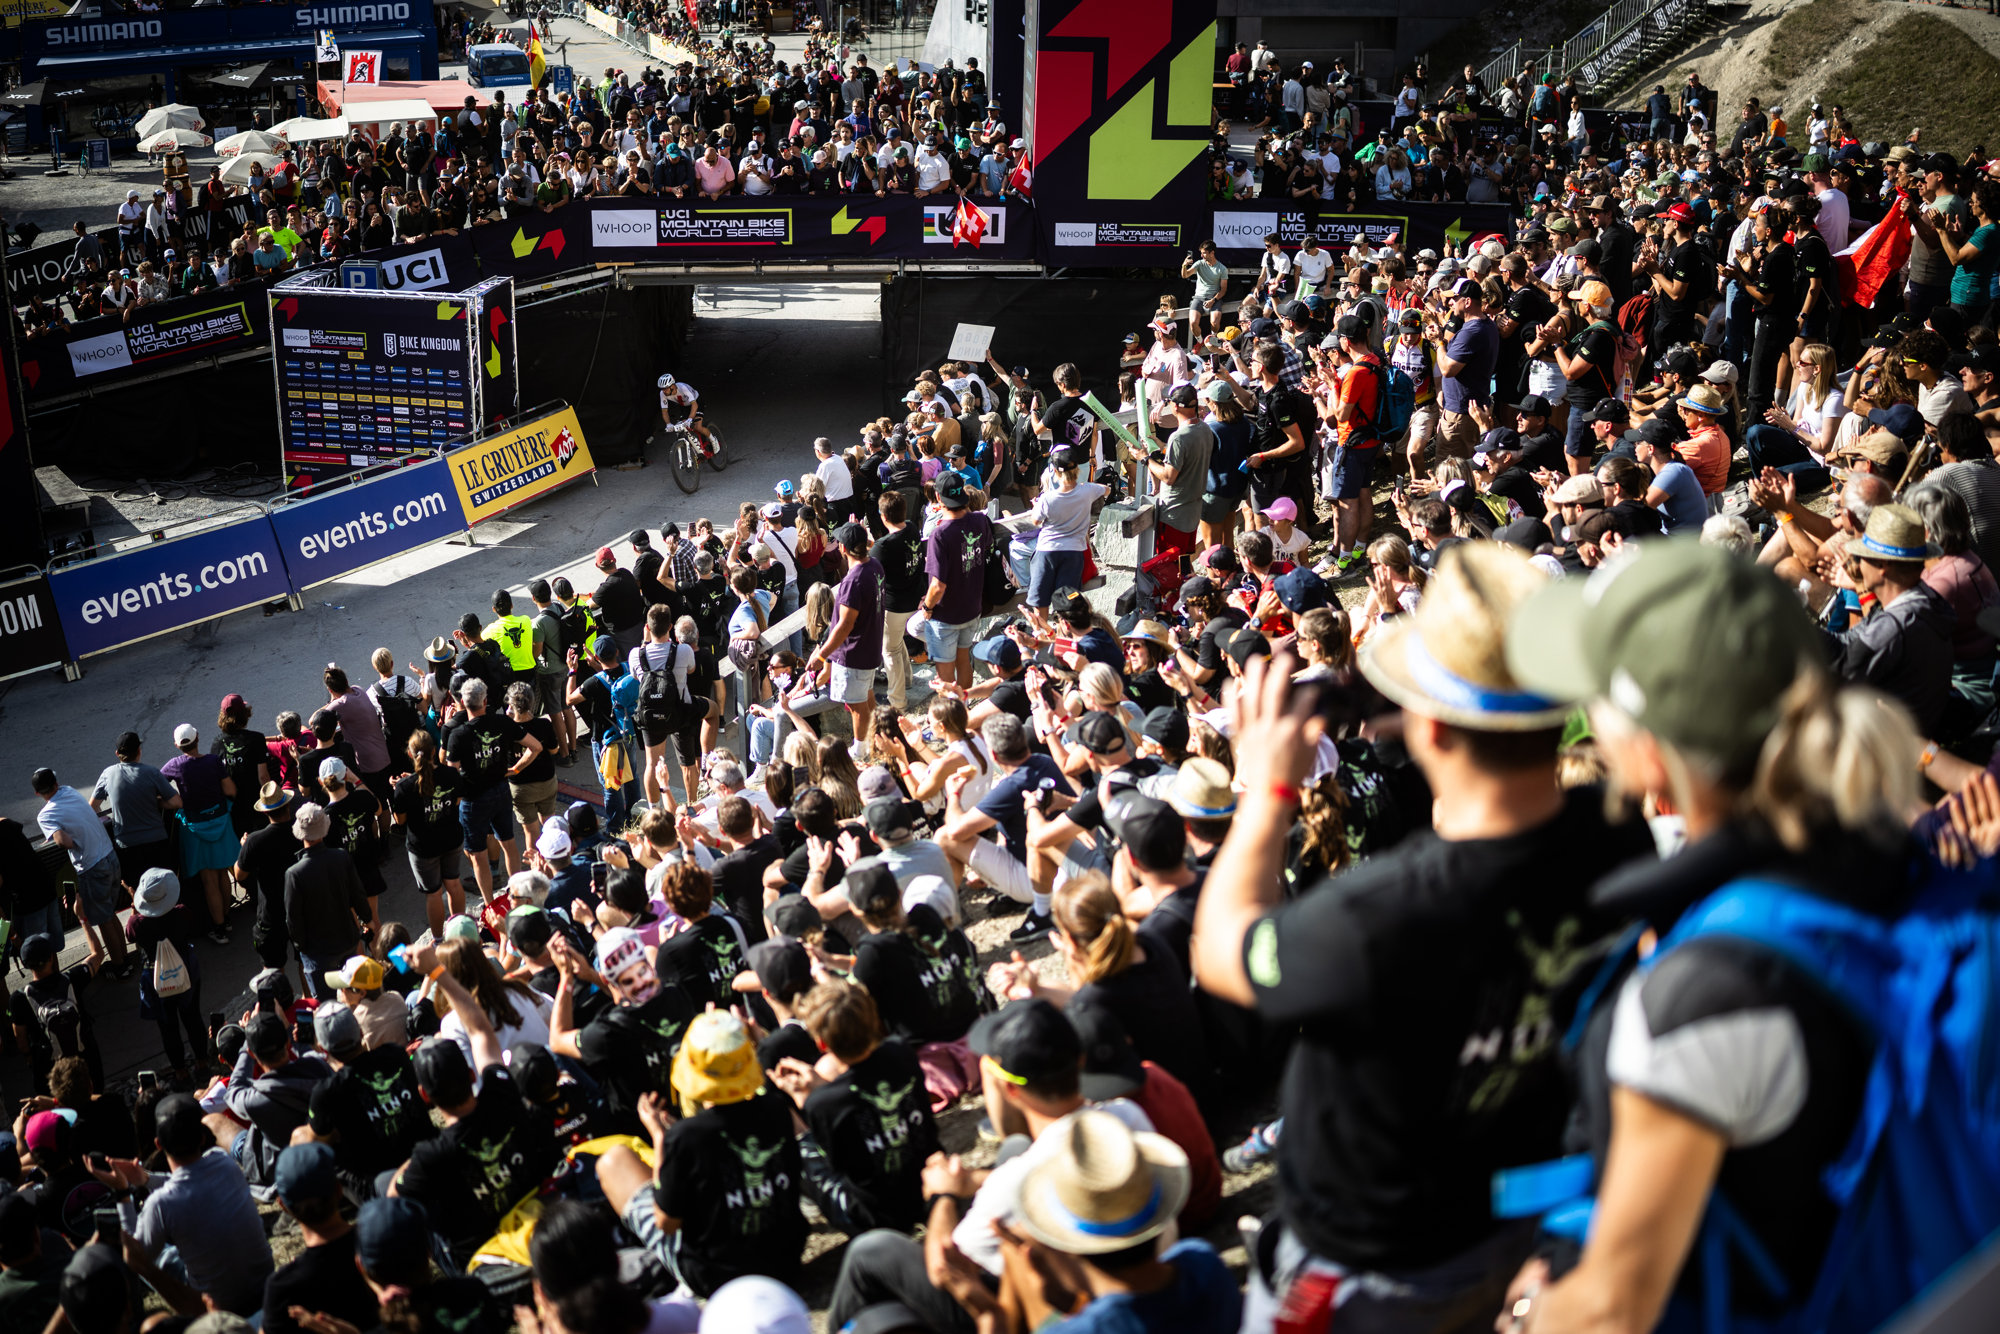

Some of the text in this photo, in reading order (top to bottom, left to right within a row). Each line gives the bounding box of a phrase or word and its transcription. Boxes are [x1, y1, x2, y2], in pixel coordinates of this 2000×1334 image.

[296, 3, 410, 26] SHIMANO
[46, 20, 162, 45] SHIMANO
[1595, 28, 1642, 70] BIKE KINGDOM
[228, 74, 250, 82] XTR
[54, 88, 85, 97] XTR
[666, 209, 689, 219] UCI
[596, 223, 652, 234] WHOOP
[660, 218, 785, 229] MOUNTAIN BIKE
[1218, 224, 1273, 236] WHOOP
[1281, 223, 1401, 234] MONTAIN BIKE
[661, 228, 785, 238] WORLD SERIES
[1058, 230, 1093, 238] WHOOP
[350, 271, 366, 288] P
[382, 255, 442, 290] UCI
[129, 313, 241, 347] MOUNTAIN BIKE
[131, 323, 154, 337] UCI
[132, 321, 244, 356] WORLD SERIES
[400, 335, 460, 351] BIKE KINGDOM
[75, 344, 124, 363] WHOOP
[557, 436, 575, 464] AOP
[458, 431, 551, 491] LE GRUYÈRE
[474, 463, 553, 505] SWITZERLAND
[300, 491, 447, 560] events.com
[81, 551, 268, 625] events.com
